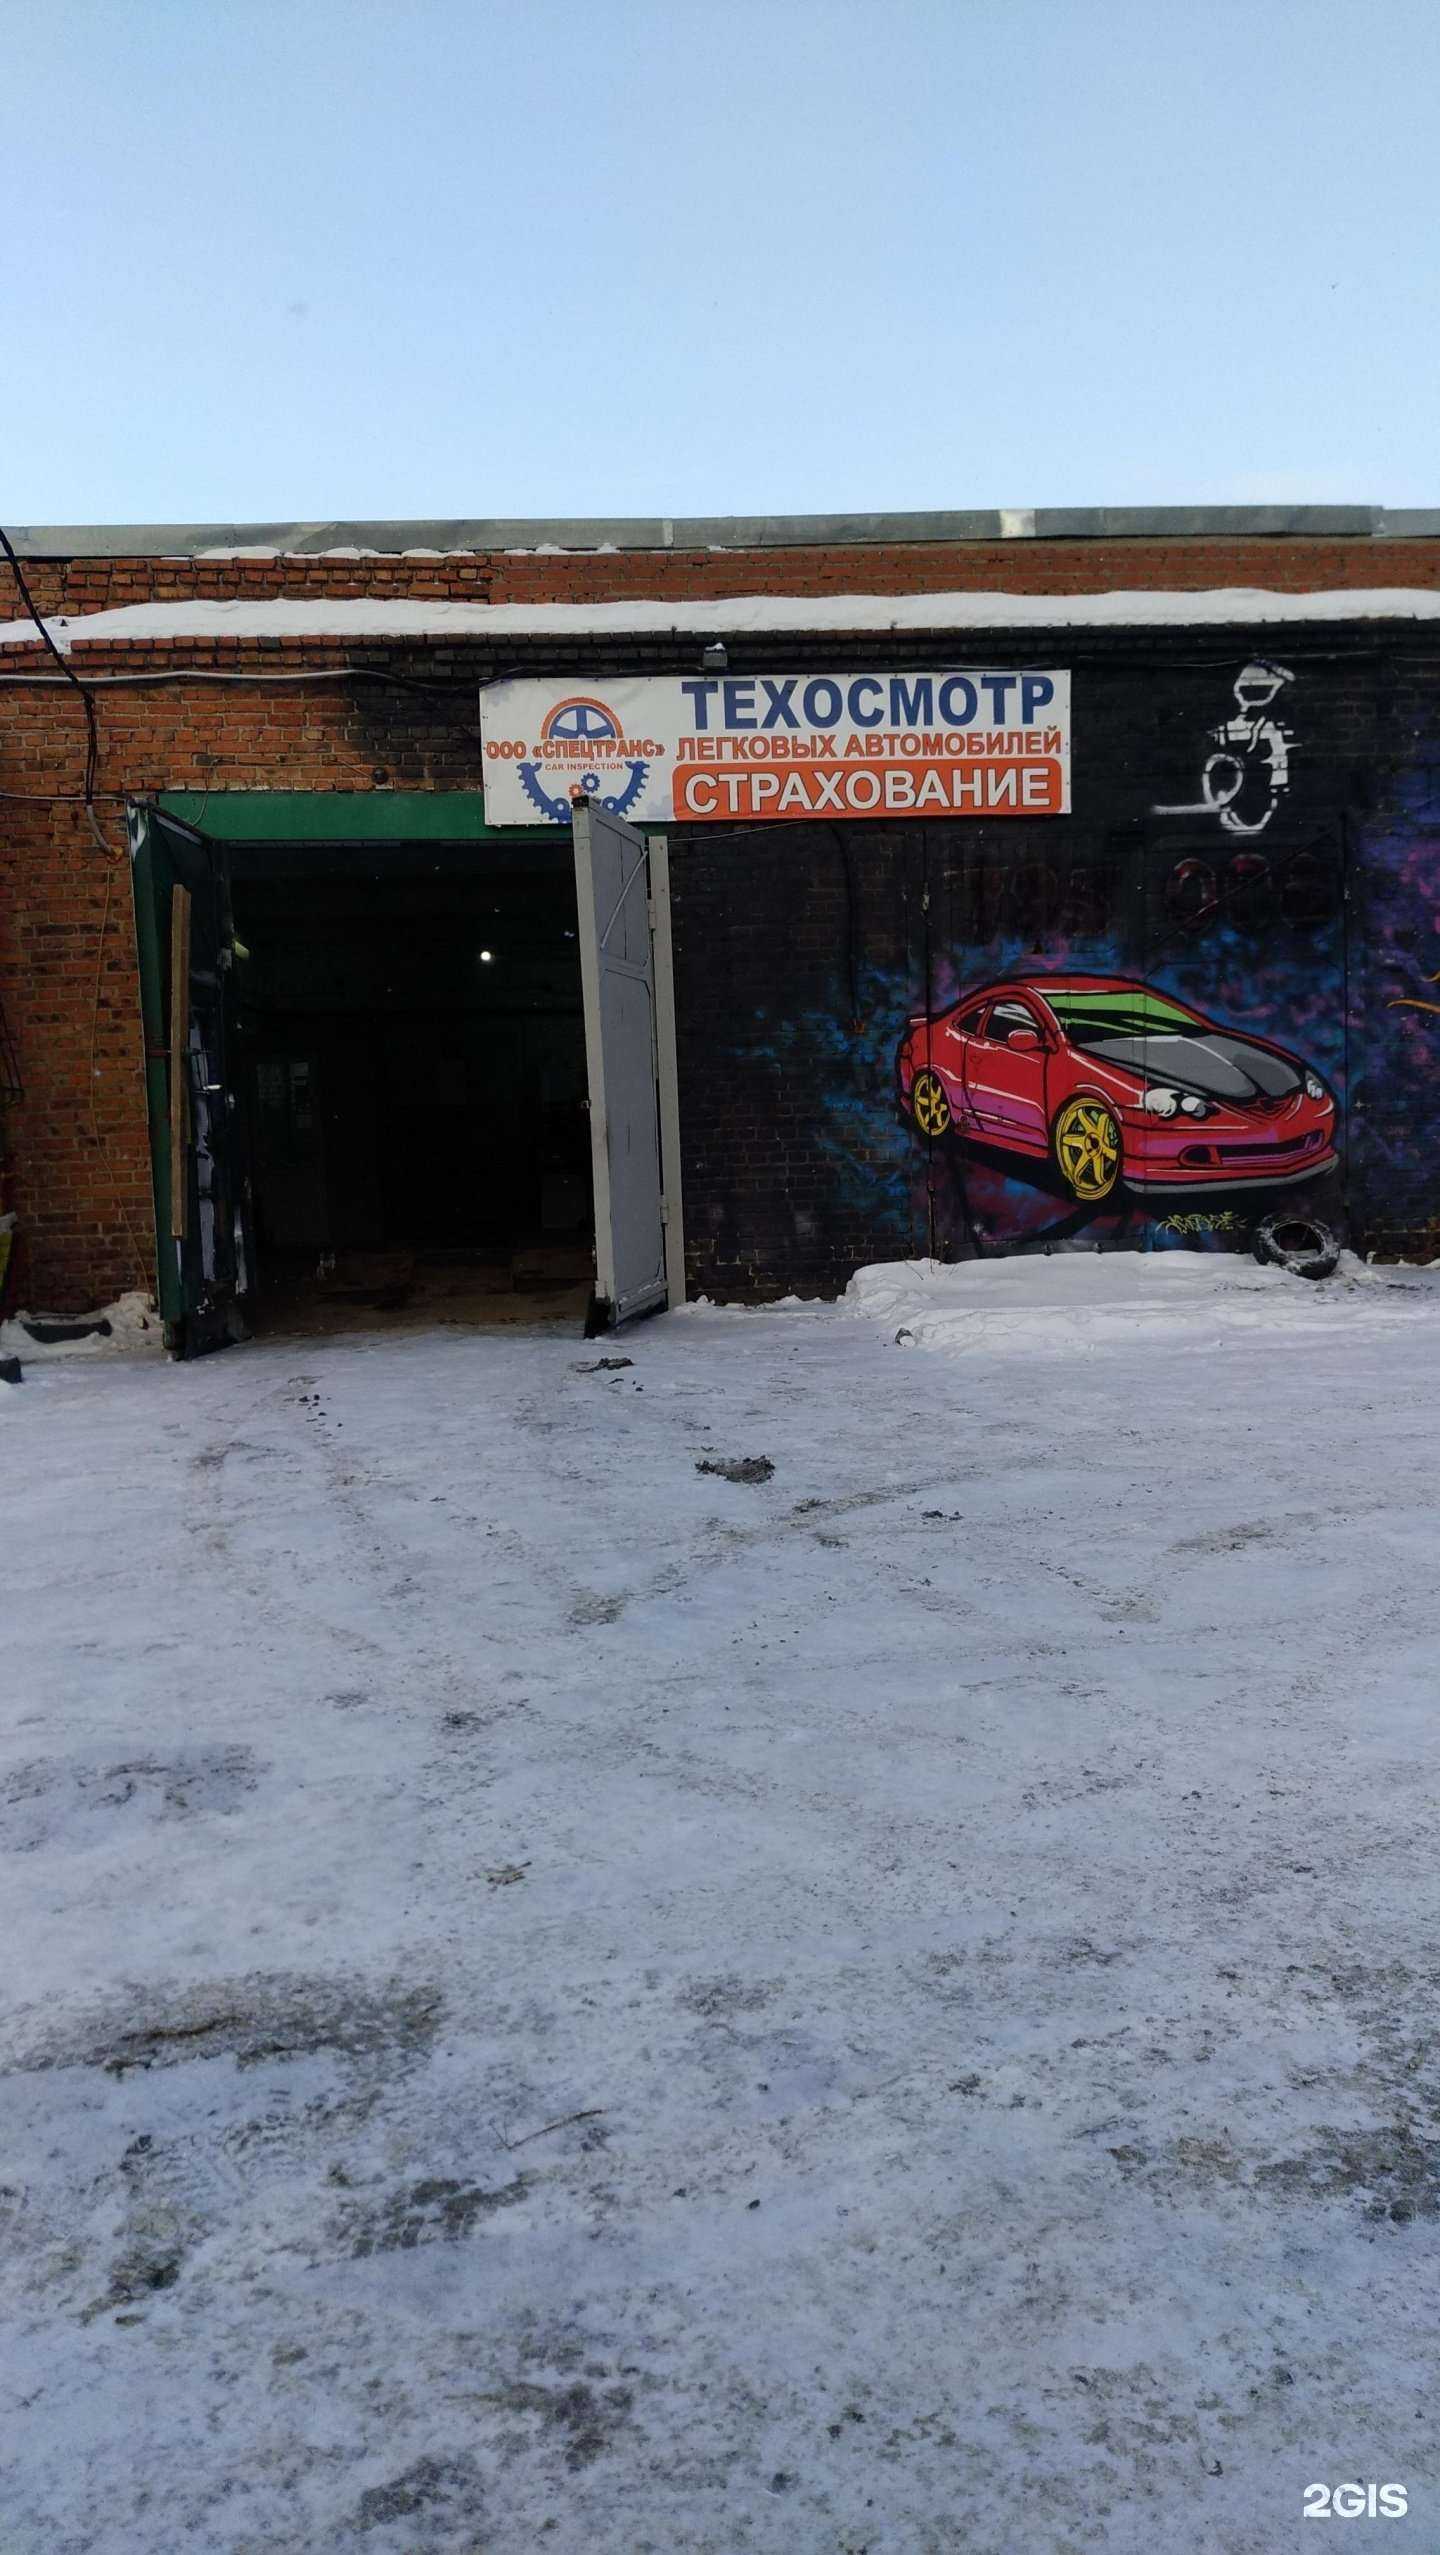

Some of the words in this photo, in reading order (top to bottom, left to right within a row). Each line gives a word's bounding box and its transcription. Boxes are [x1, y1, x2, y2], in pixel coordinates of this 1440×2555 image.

[681, 676, 1055, 730] ТЕХОСМОТР
[486, 741, 527, 759] ООО
[532, 739, 666, 761] «СПЕЦТРАНС»
[676, 734, 837, 761] ЛЕГКОВЫХ
[844, 725, 1062, 758] АВТОМОБИЛЕЙ
[544, 763, 566, 771] CAR
[567, 762, 624, 771] INSPECTION
[684, 767, 1051, 814] СТРАХОВАНИЕ
